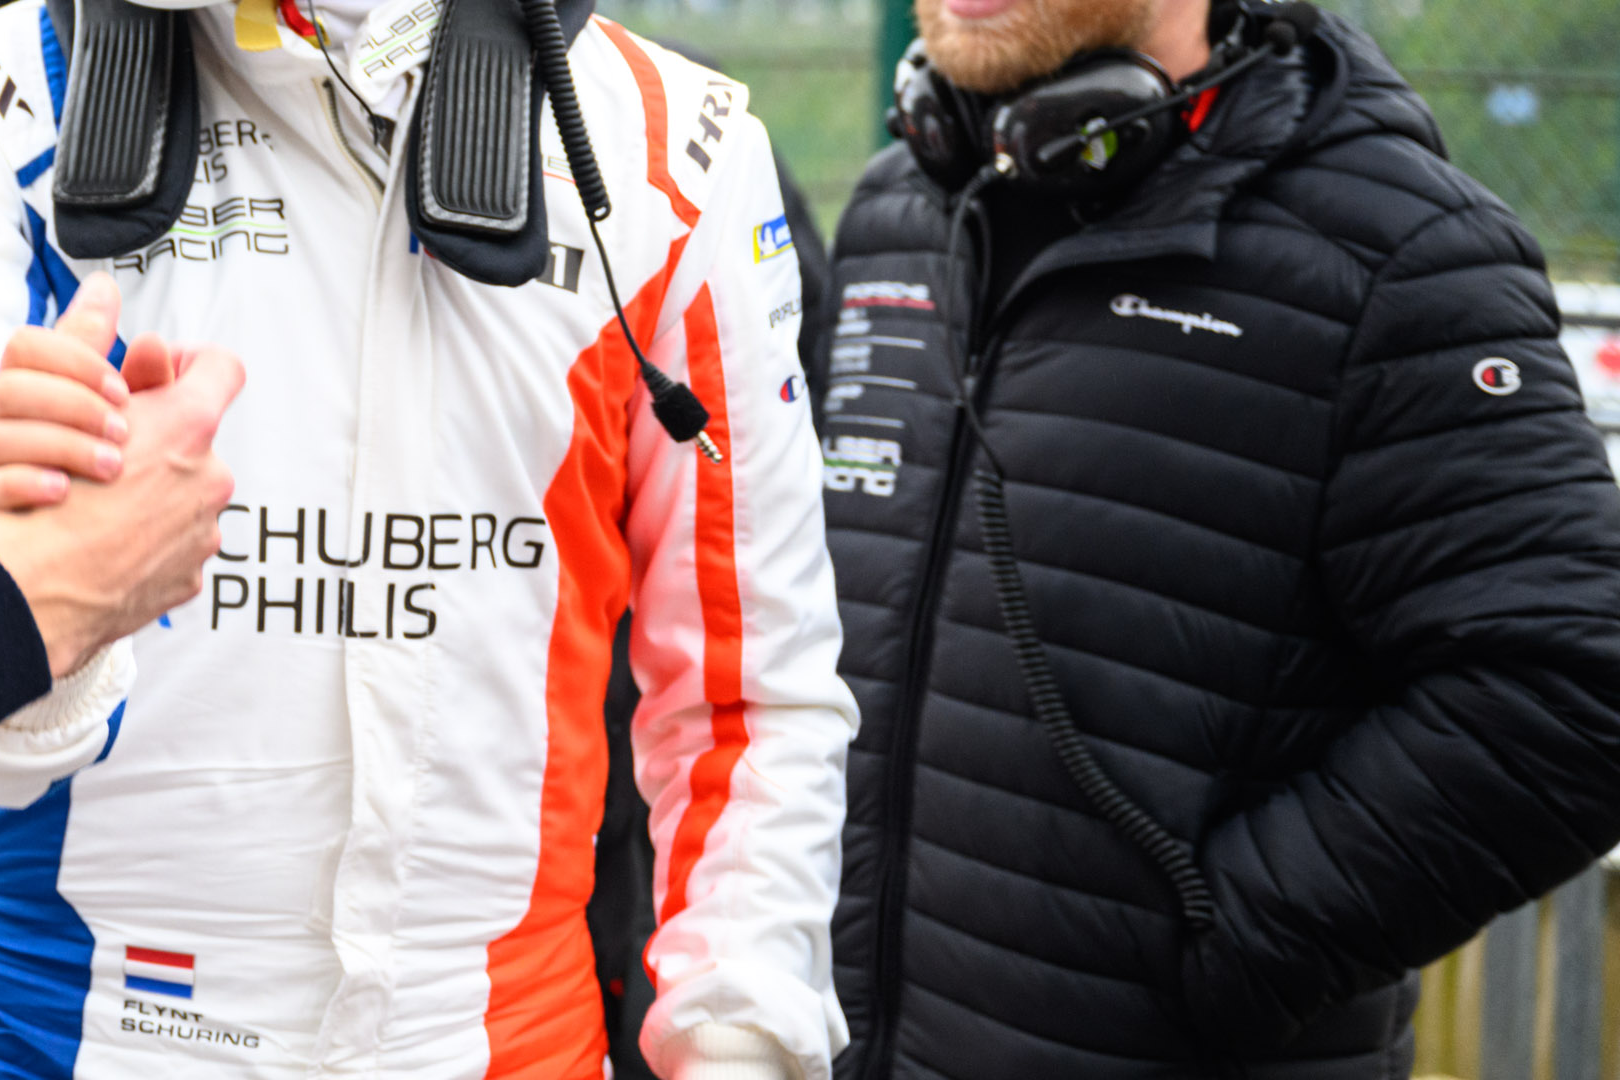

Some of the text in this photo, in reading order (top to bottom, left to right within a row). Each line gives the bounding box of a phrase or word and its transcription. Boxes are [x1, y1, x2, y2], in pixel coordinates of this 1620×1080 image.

[180, 197, 286, 228] BER
[215, 503, 547, 571] CHUBERG
[210, 573, 438, 641] PHILIS
[123, 999, 205, 1024] FLYNT
[120, 1017, 261, 1050] SCHURING
